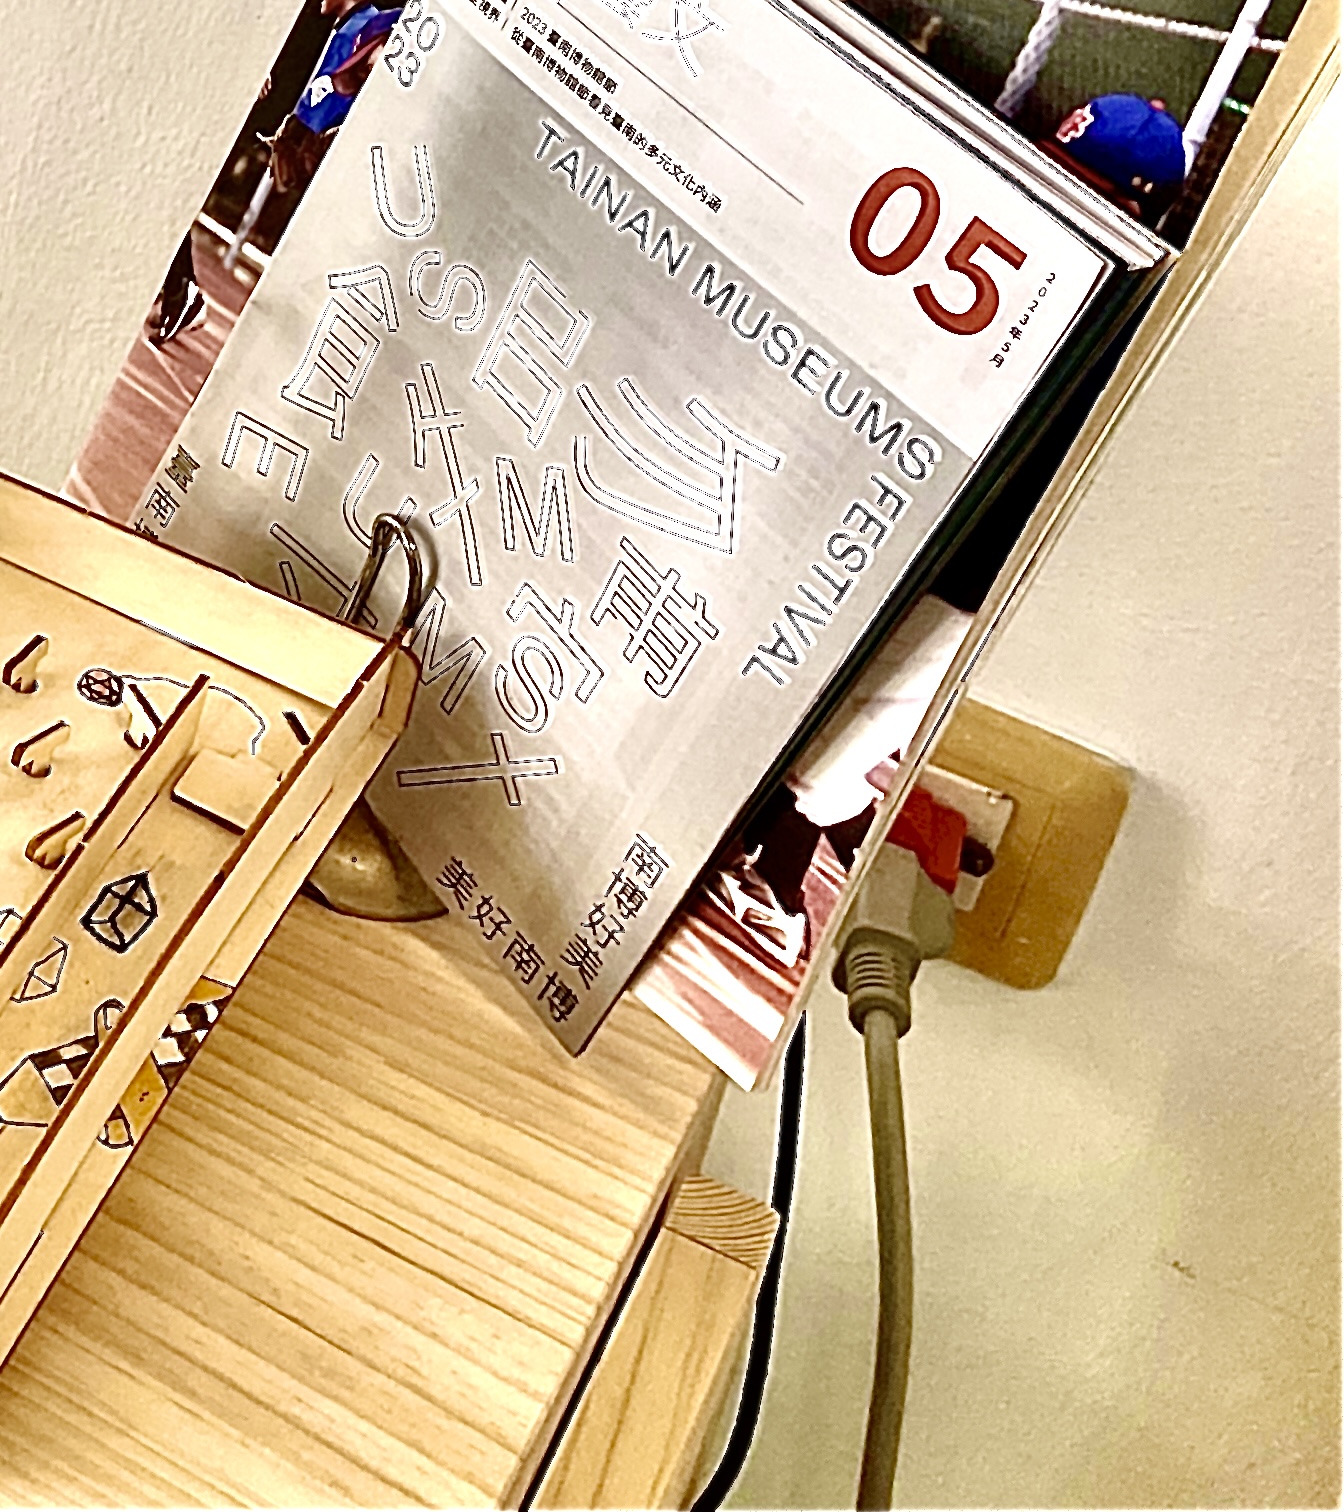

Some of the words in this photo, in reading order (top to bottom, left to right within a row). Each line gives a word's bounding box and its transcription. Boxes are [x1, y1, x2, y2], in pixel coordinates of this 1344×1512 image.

[383, 33, 421, 88] 23
[520, 5, 549, 36] 2023
[536, 120, 691, 276] TAINAN
[849, 166, 1028, 336] 05
[691, 260, 943, 484] MUSEUMS
[740, 472, 914, 688] FESTIVAL
[435, 855, 580, 1024] 美好南博
[559, 832, 670, 991] 南博好美
